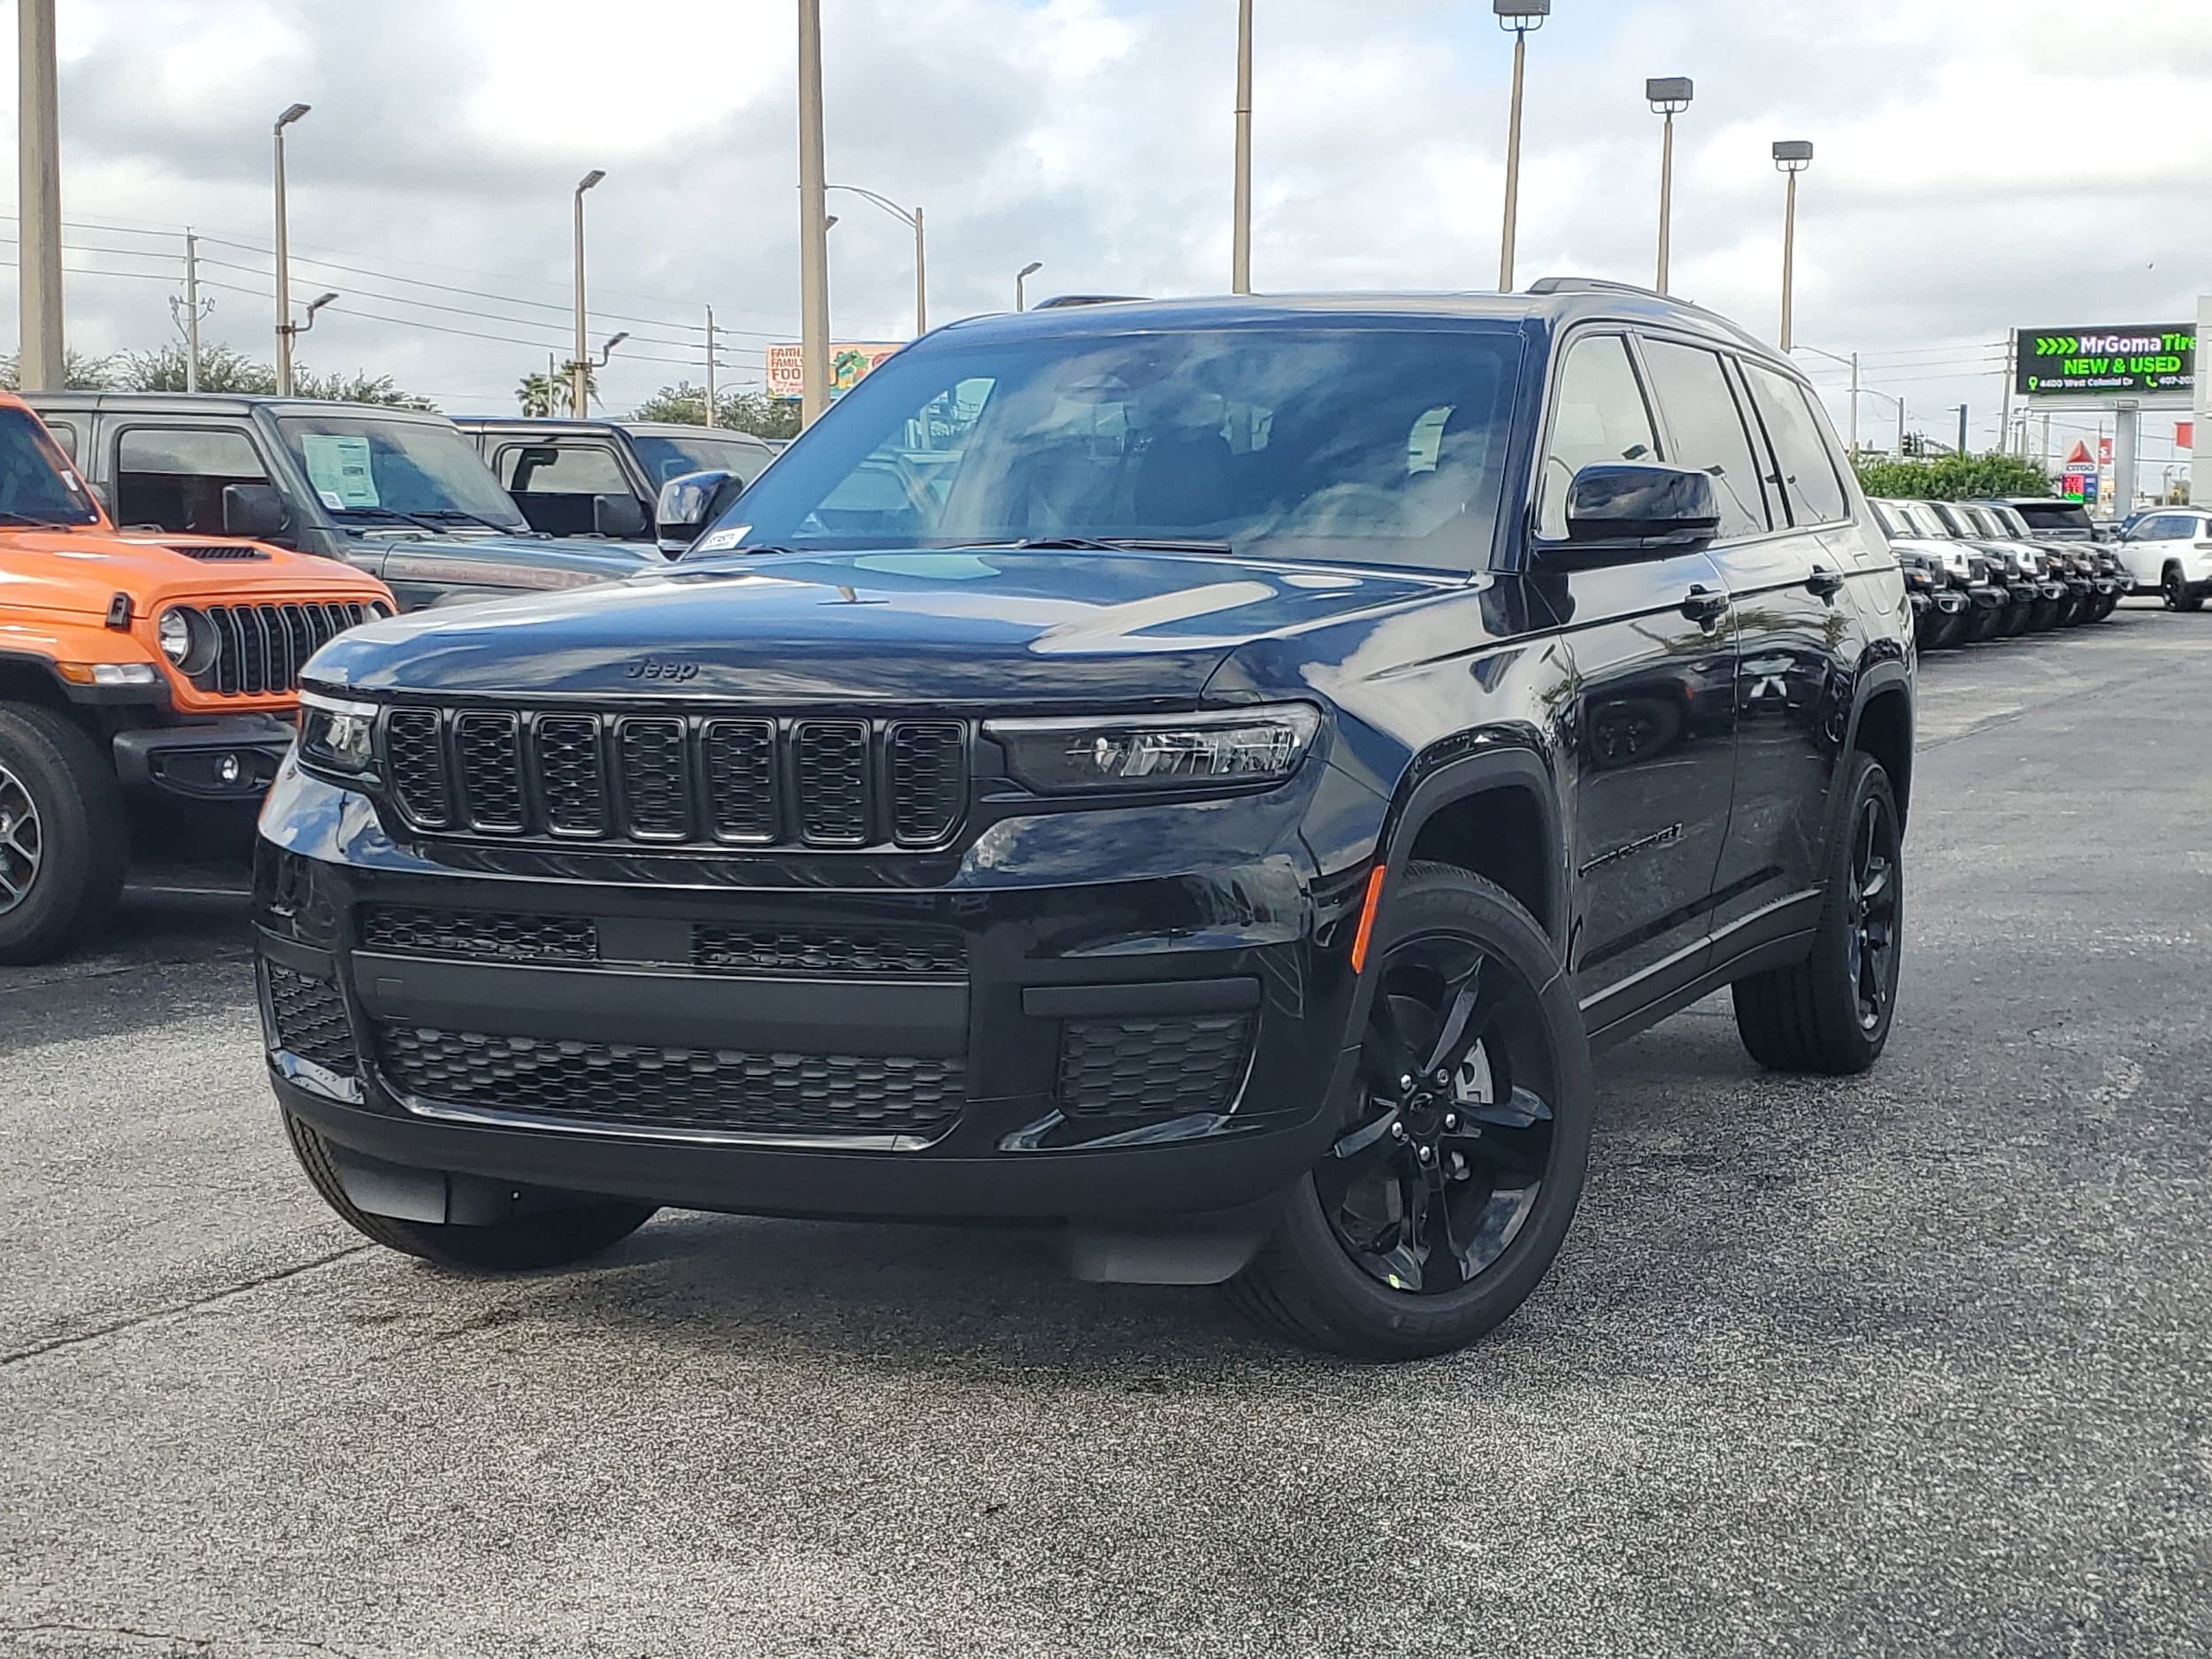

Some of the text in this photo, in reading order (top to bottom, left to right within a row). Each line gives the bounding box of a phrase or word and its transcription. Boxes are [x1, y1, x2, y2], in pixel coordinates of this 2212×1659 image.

[772, 368, 802, 380] FOO
[2063, 356, 2181, 375] NEW & USED
[625, 659, 699, 682] Jeep
